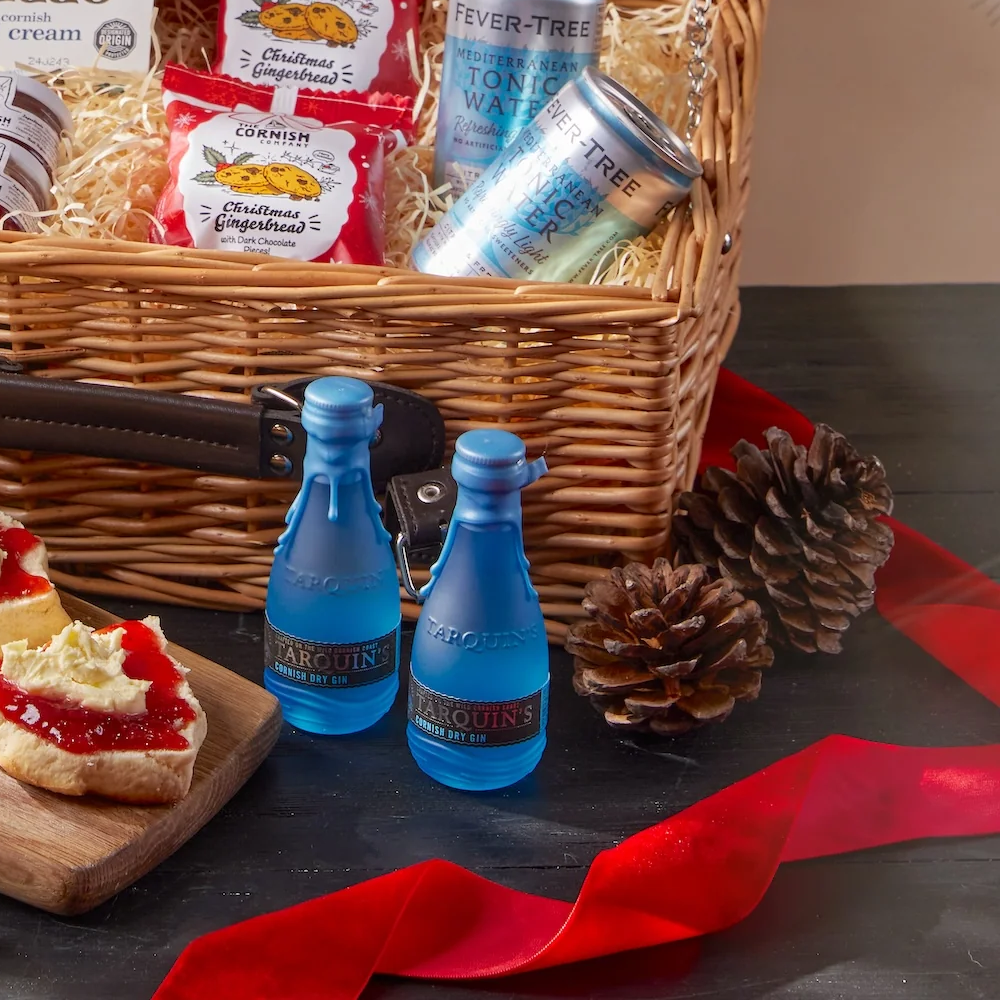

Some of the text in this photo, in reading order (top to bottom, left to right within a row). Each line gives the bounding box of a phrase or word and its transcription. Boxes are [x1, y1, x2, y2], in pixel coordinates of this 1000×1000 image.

[1, 12, 52, 23] cornish
[455, 2, 592, 37] FEVER-TREE
[8, 27, 82, 42] cream
[98, 35, 132, 46] ORIGIN
[261, 47, 334, 68] Christmas
[456, 47, 579, 72] MEDITERRANEAN
[251, 62, 338, 85] Gingerbread
[468, 66, 559, 96] TONIC
[464, 89, 540, 119] WATE
[235, 128, 310, 143] CORNISH
[260, 140, 309, 148] COMPANY
[464, 140, 504, 151] ARTIFICIA
[546, 98, 642, 198] EVER-TREE
[223, 201, 301, 219] Christmas
[214, 213, 306, 234] Gingerbread
[220, 235, 297, 248] with Dark Chocolate
[513, 235, 550, 265] Light
[491, 234, 534, 275] SWEETENERS
[427, 615, 540, 653] TARQUIN'S
[275, 641, 391, 674] TARQUIN'S
[304, 643, 315, 651] THE
[361, 642, 379, 651] COAST
[274, 661, 348, 685] CORNISH DRY GIN
[416, 693, 533, 731] TARQUIN'S
[455, 703, 471, 711] WILD
[415, 714, 487, 743] CORNISH DRY GIN
